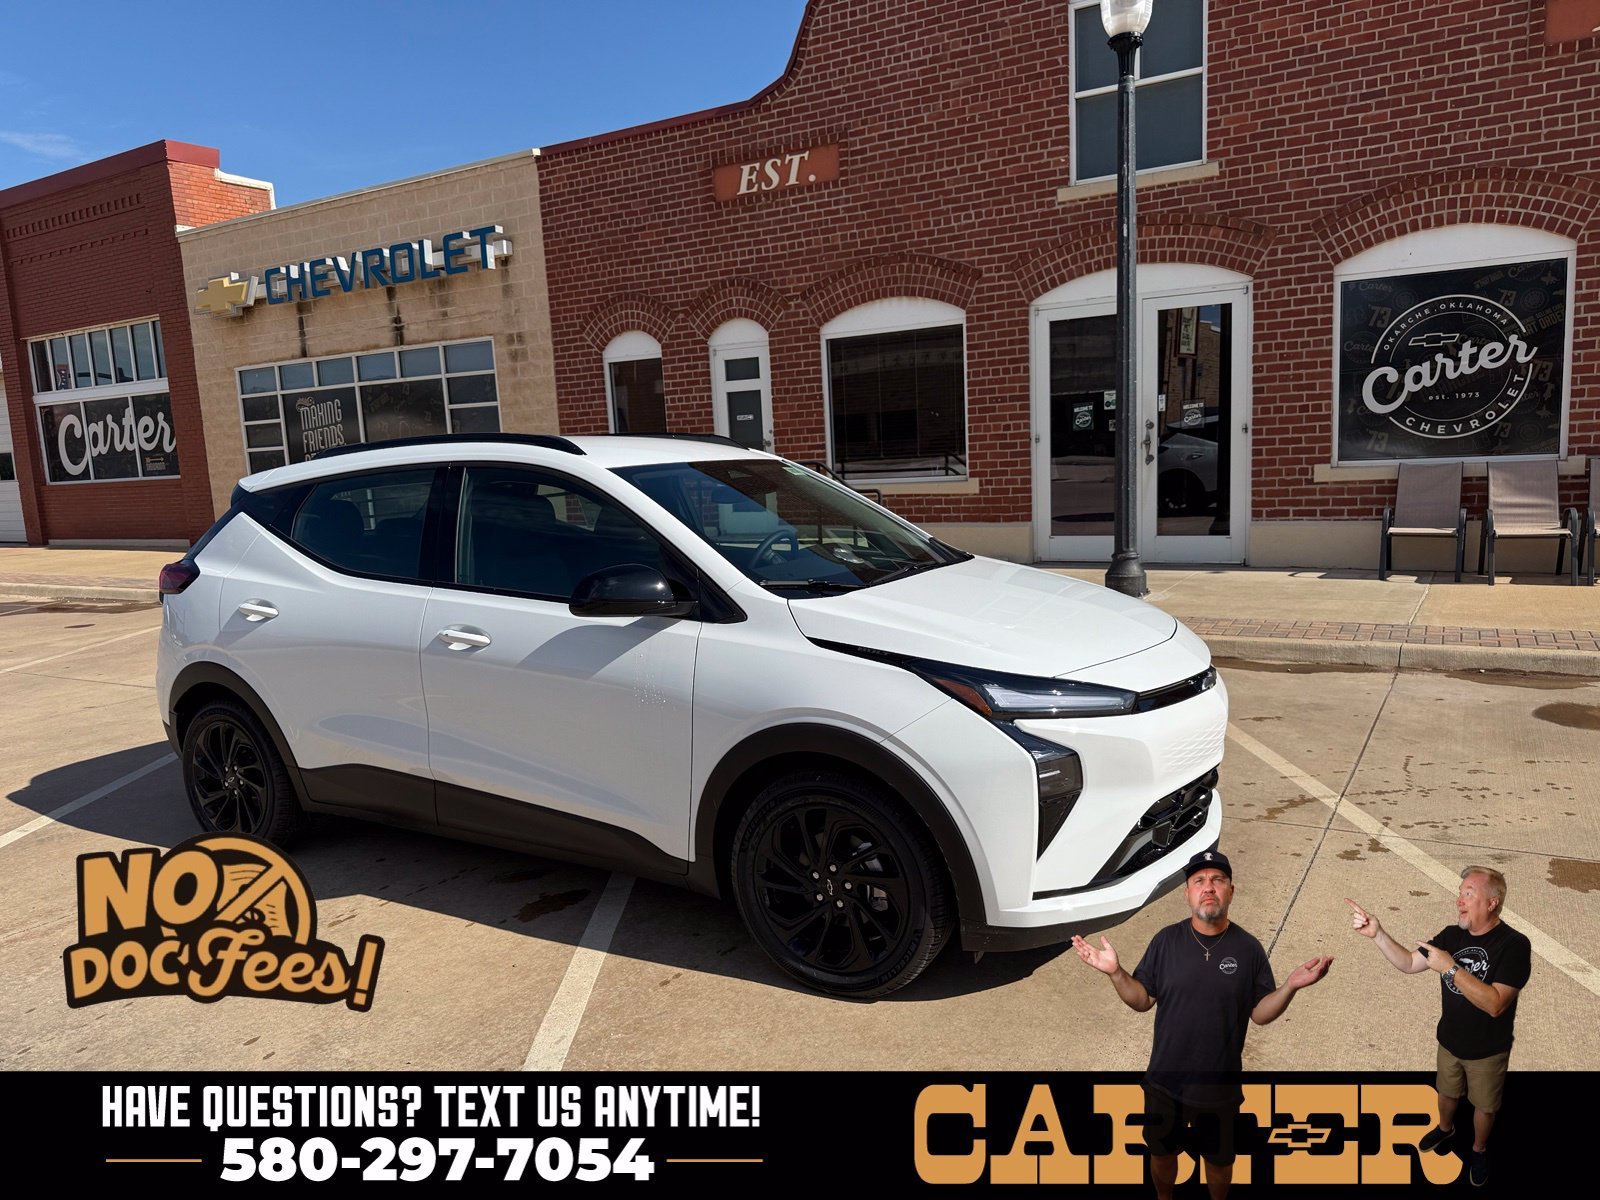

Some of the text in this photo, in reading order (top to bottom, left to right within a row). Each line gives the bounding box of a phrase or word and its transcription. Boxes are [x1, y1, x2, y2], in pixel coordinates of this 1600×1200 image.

[737, 150, 817, 196] EST.
[264, 225, 501, 305] CHEVROLET
[1440, 301, 1508, 326] OKLAHOMA
[1362, 334, 1538, 414] Carter
[1455, 391, 1480, 399] 1973
[300, 399, 342, 430] MAKING
[1406, 374, 1525, 434] CHEVROLET
[58, 407, 176, 476] Carter
